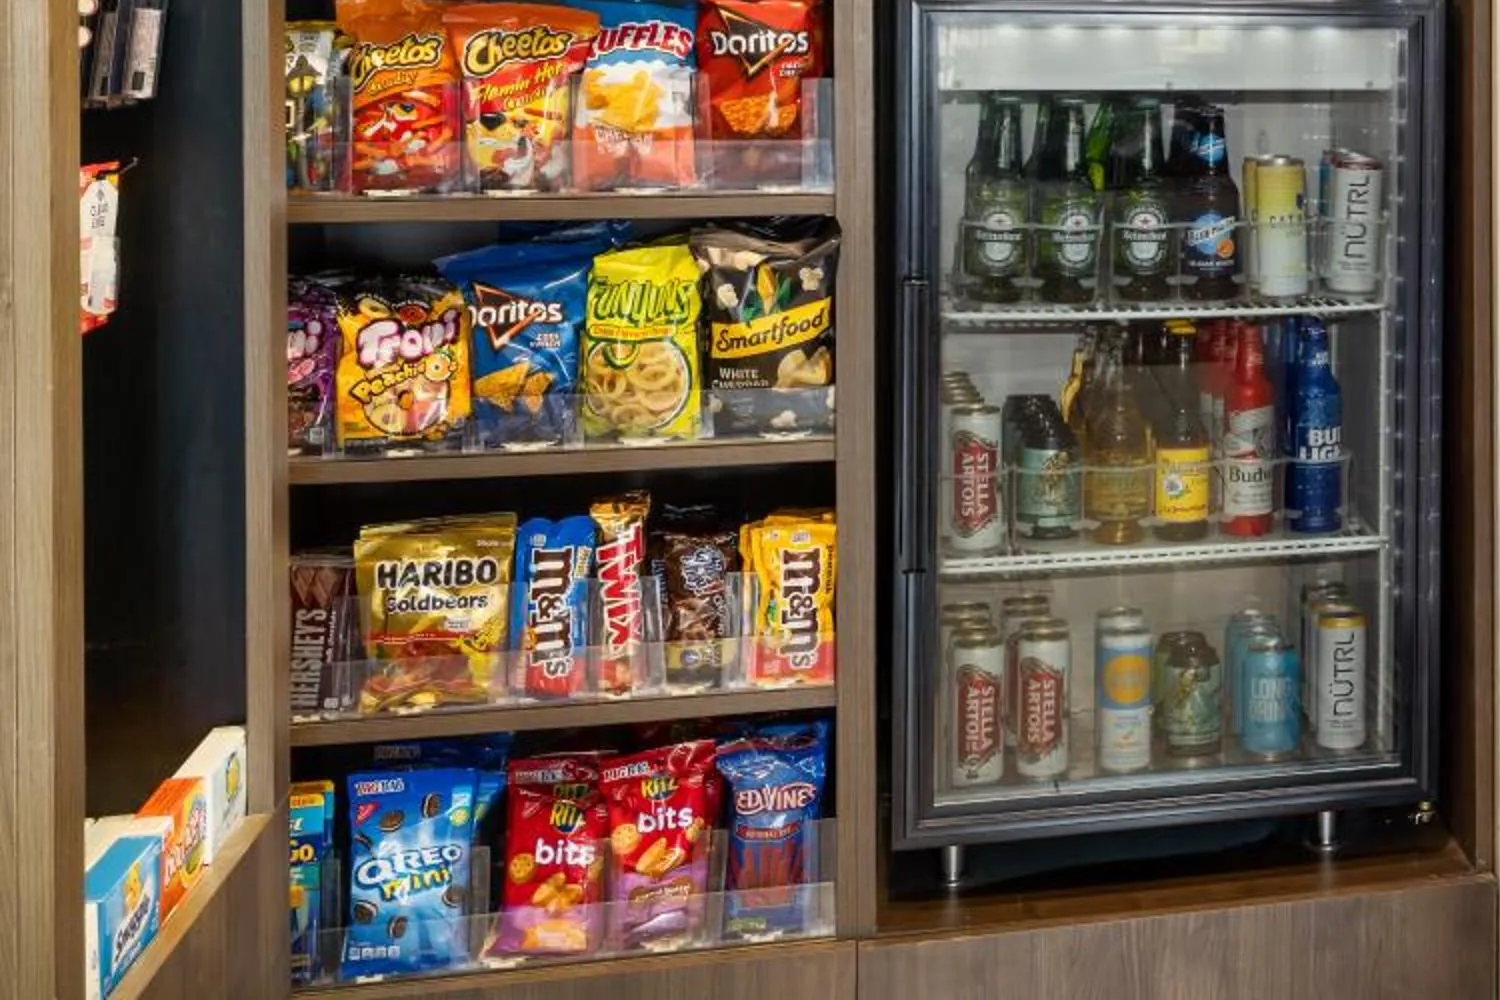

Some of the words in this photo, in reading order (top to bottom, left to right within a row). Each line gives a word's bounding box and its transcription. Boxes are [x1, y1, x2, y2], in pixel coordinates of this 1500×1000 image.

[352, 35, 442, 82] Cheetos
[465, 26, 572, 77] Cheetos
[711, 30, 809, 56] Doritos
[716, 306, 825, 351] Smartfood
[719, 367, 760, 380] WHITE
[960, 451, 975, 518] ARTOIS
[976, 451, 989, 515] STELLA
[376, 557, 499, 589] HARIBO
[387, 588, 489, 613] Goldbears
[529, 547, 575, 679] m&m's
[779, 547, 822, 670] m&m's
[289, 608, 327, 712] HERSHEY'S
[636, 804, 694, 833] bits
[356, 843, 463, 886] OREO
[534, 838, 597, 867] bits
[382, 865, 452, 901] mini
